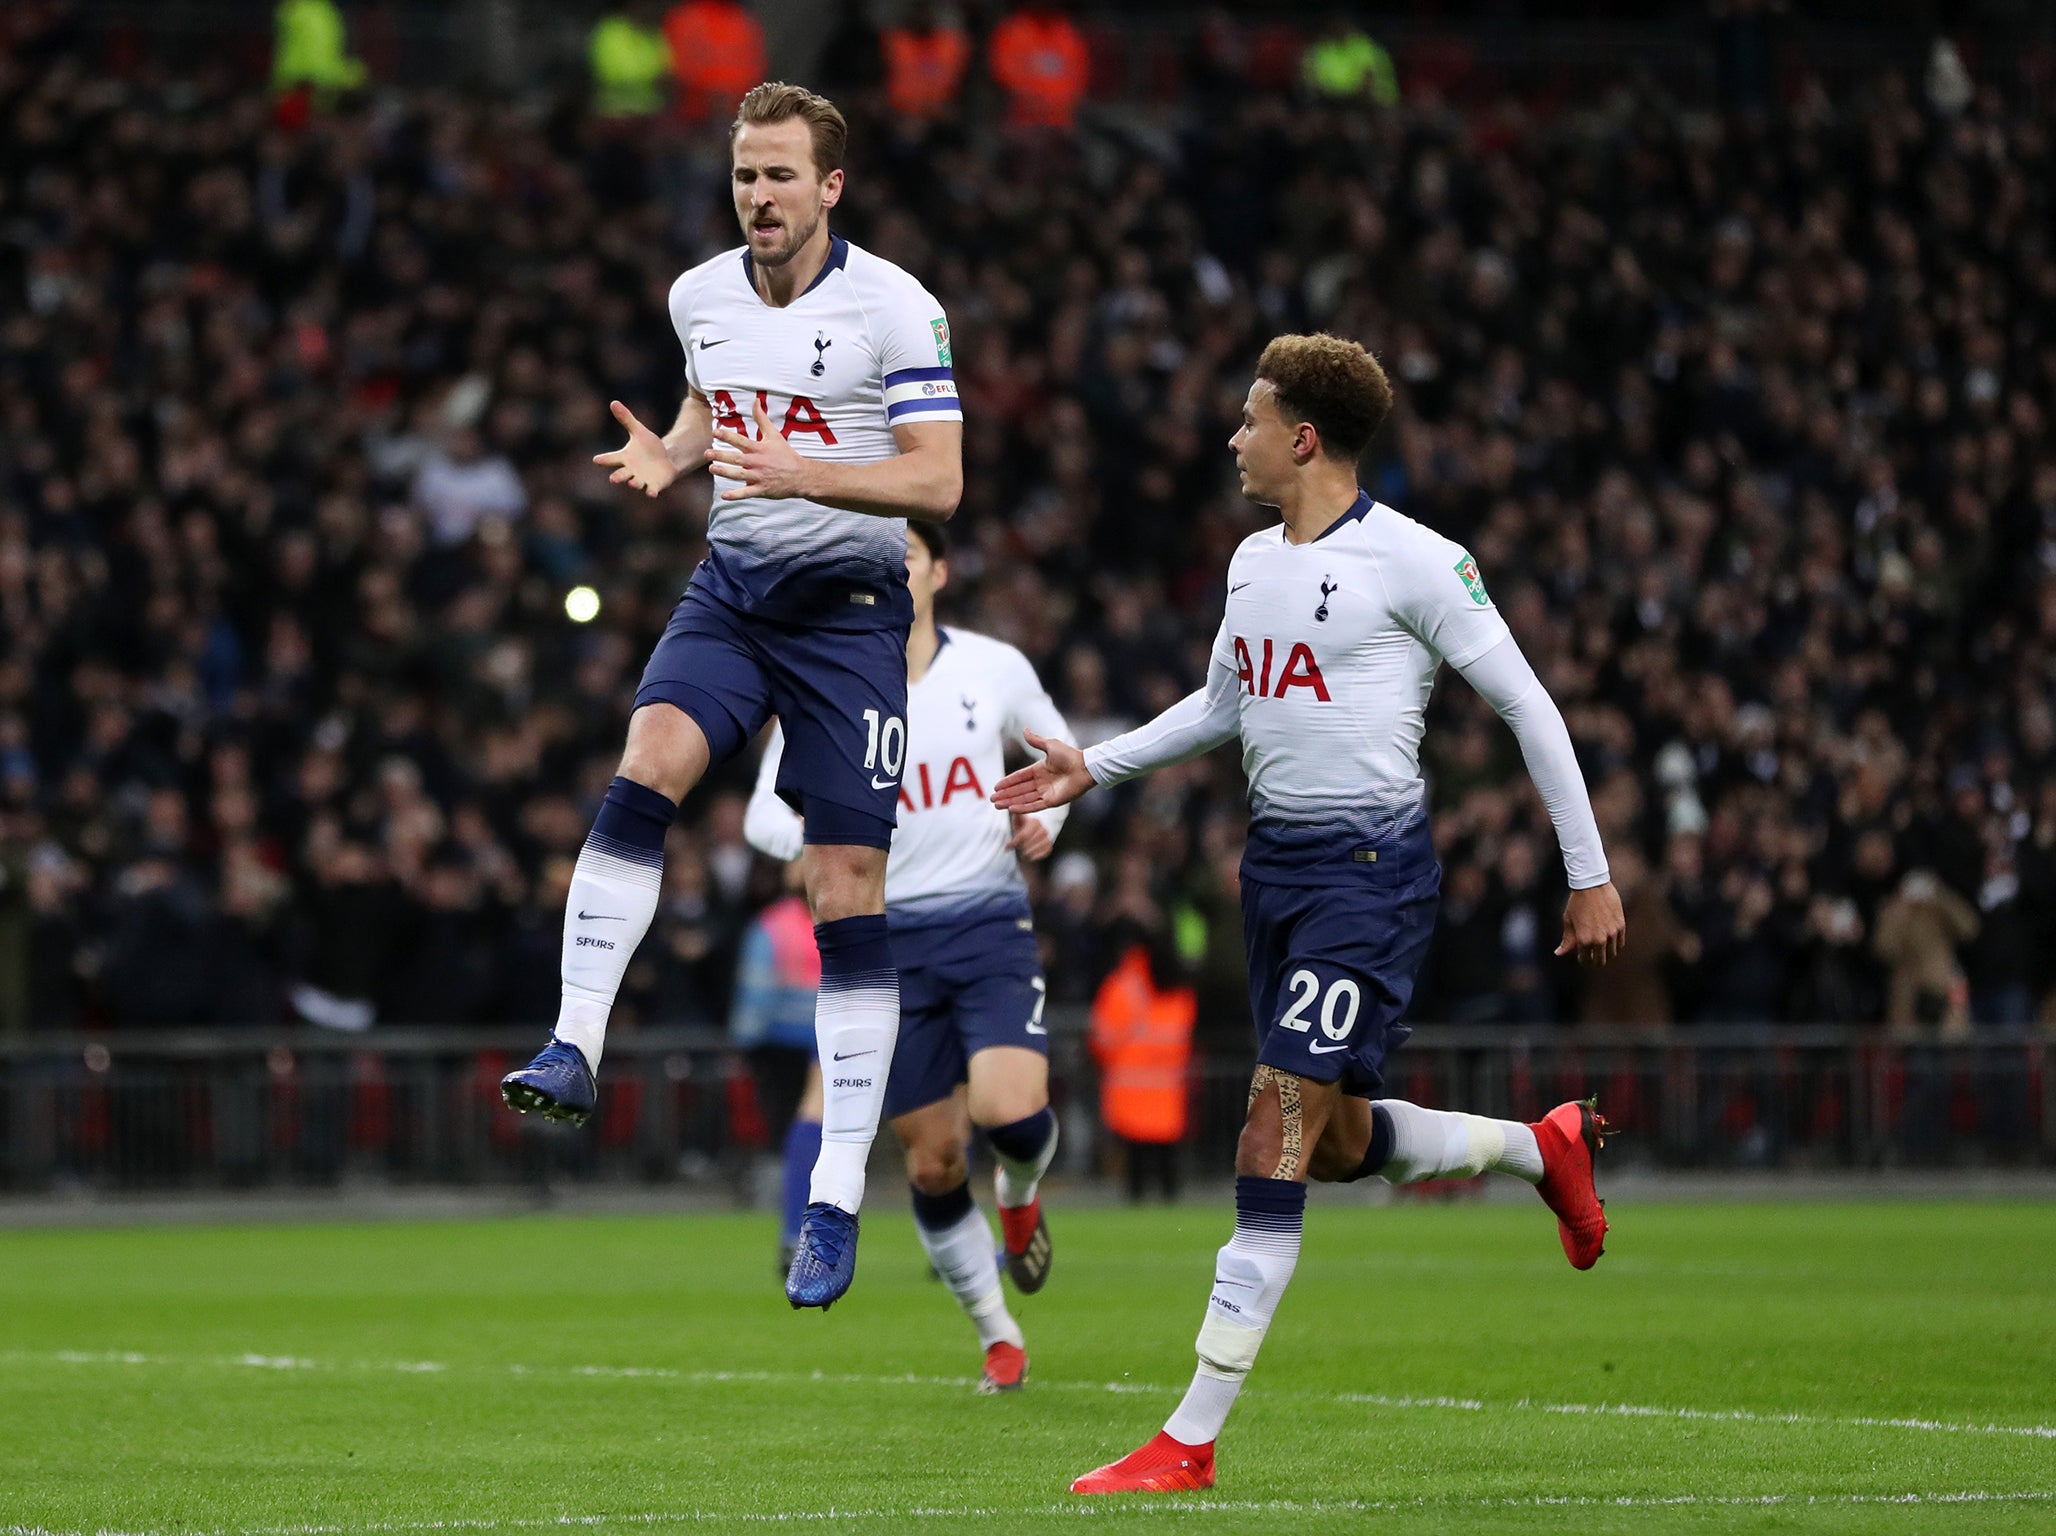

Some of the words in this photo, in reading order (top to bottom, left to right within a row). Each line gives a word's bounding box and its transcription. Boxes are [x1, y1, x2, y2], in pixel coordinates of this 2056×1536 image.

[936, 385, 951, 393] EFL
[1235, 636, 1331, 702] AIA
[863, 709, 905, 777] 10
[576, 936, 615, 951] SPURS
[1279, 969, 1360, 1041] 20
[833, 1078, 872, 1088] SPURS
[1211, 1294, 1241, 1313] PURS
